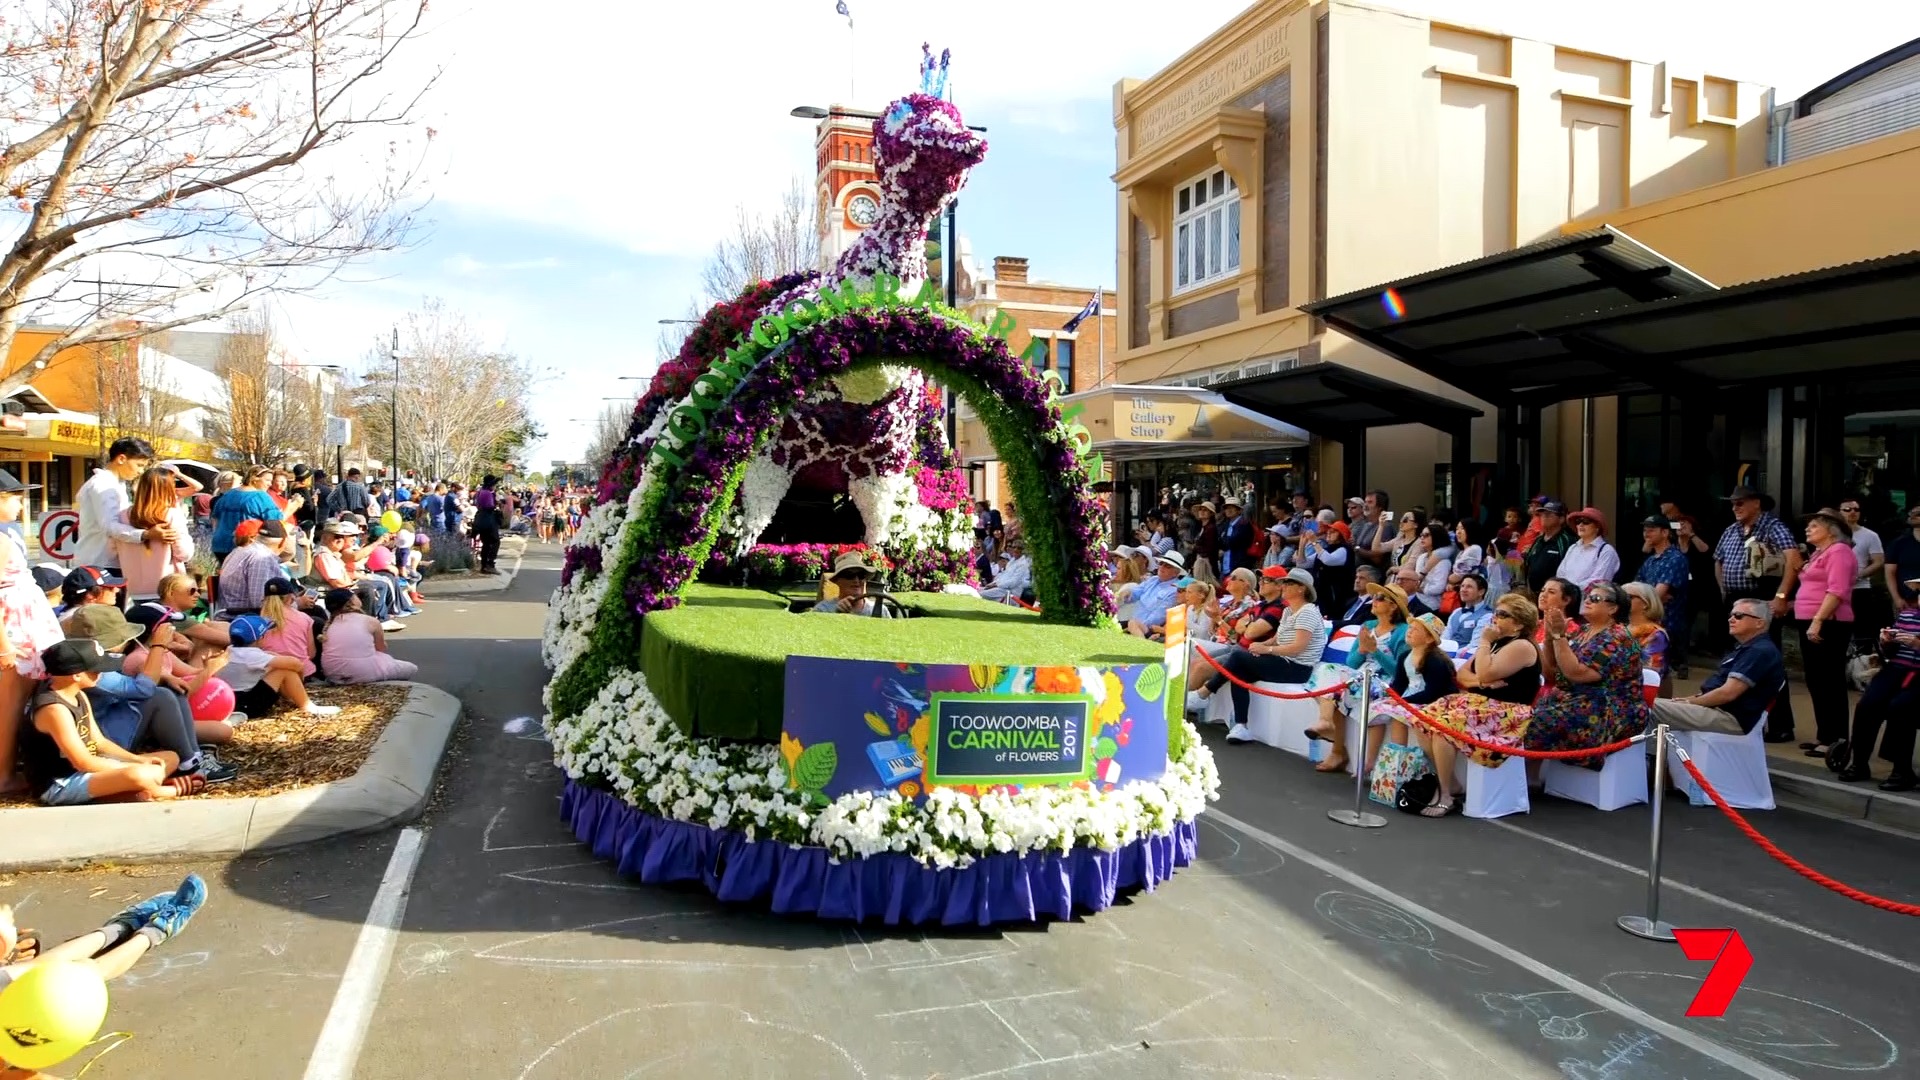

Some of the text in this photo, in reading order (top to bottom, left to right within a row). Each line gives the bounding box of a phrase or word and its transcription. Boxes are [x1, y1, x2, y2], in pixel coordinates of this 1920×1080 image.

[1255, 22, 1291, 59] LIGHT
[1157, 109, 1187, 138] POWER
[1190, 80, 1237, 115] COMPANY
[1131, 397, 1153, 410] The
[1131, 412, 1175, 426] Gallery
[1131, 425, 1164, 439] Shop
[949, 715, 1060, 731] TOOWOOMBA
[947, 730, 1060, 750] CARNIVAL
[1063, 719, 1077, 756] 2017
[995, 751, 1060, 763] of FLOWERS
